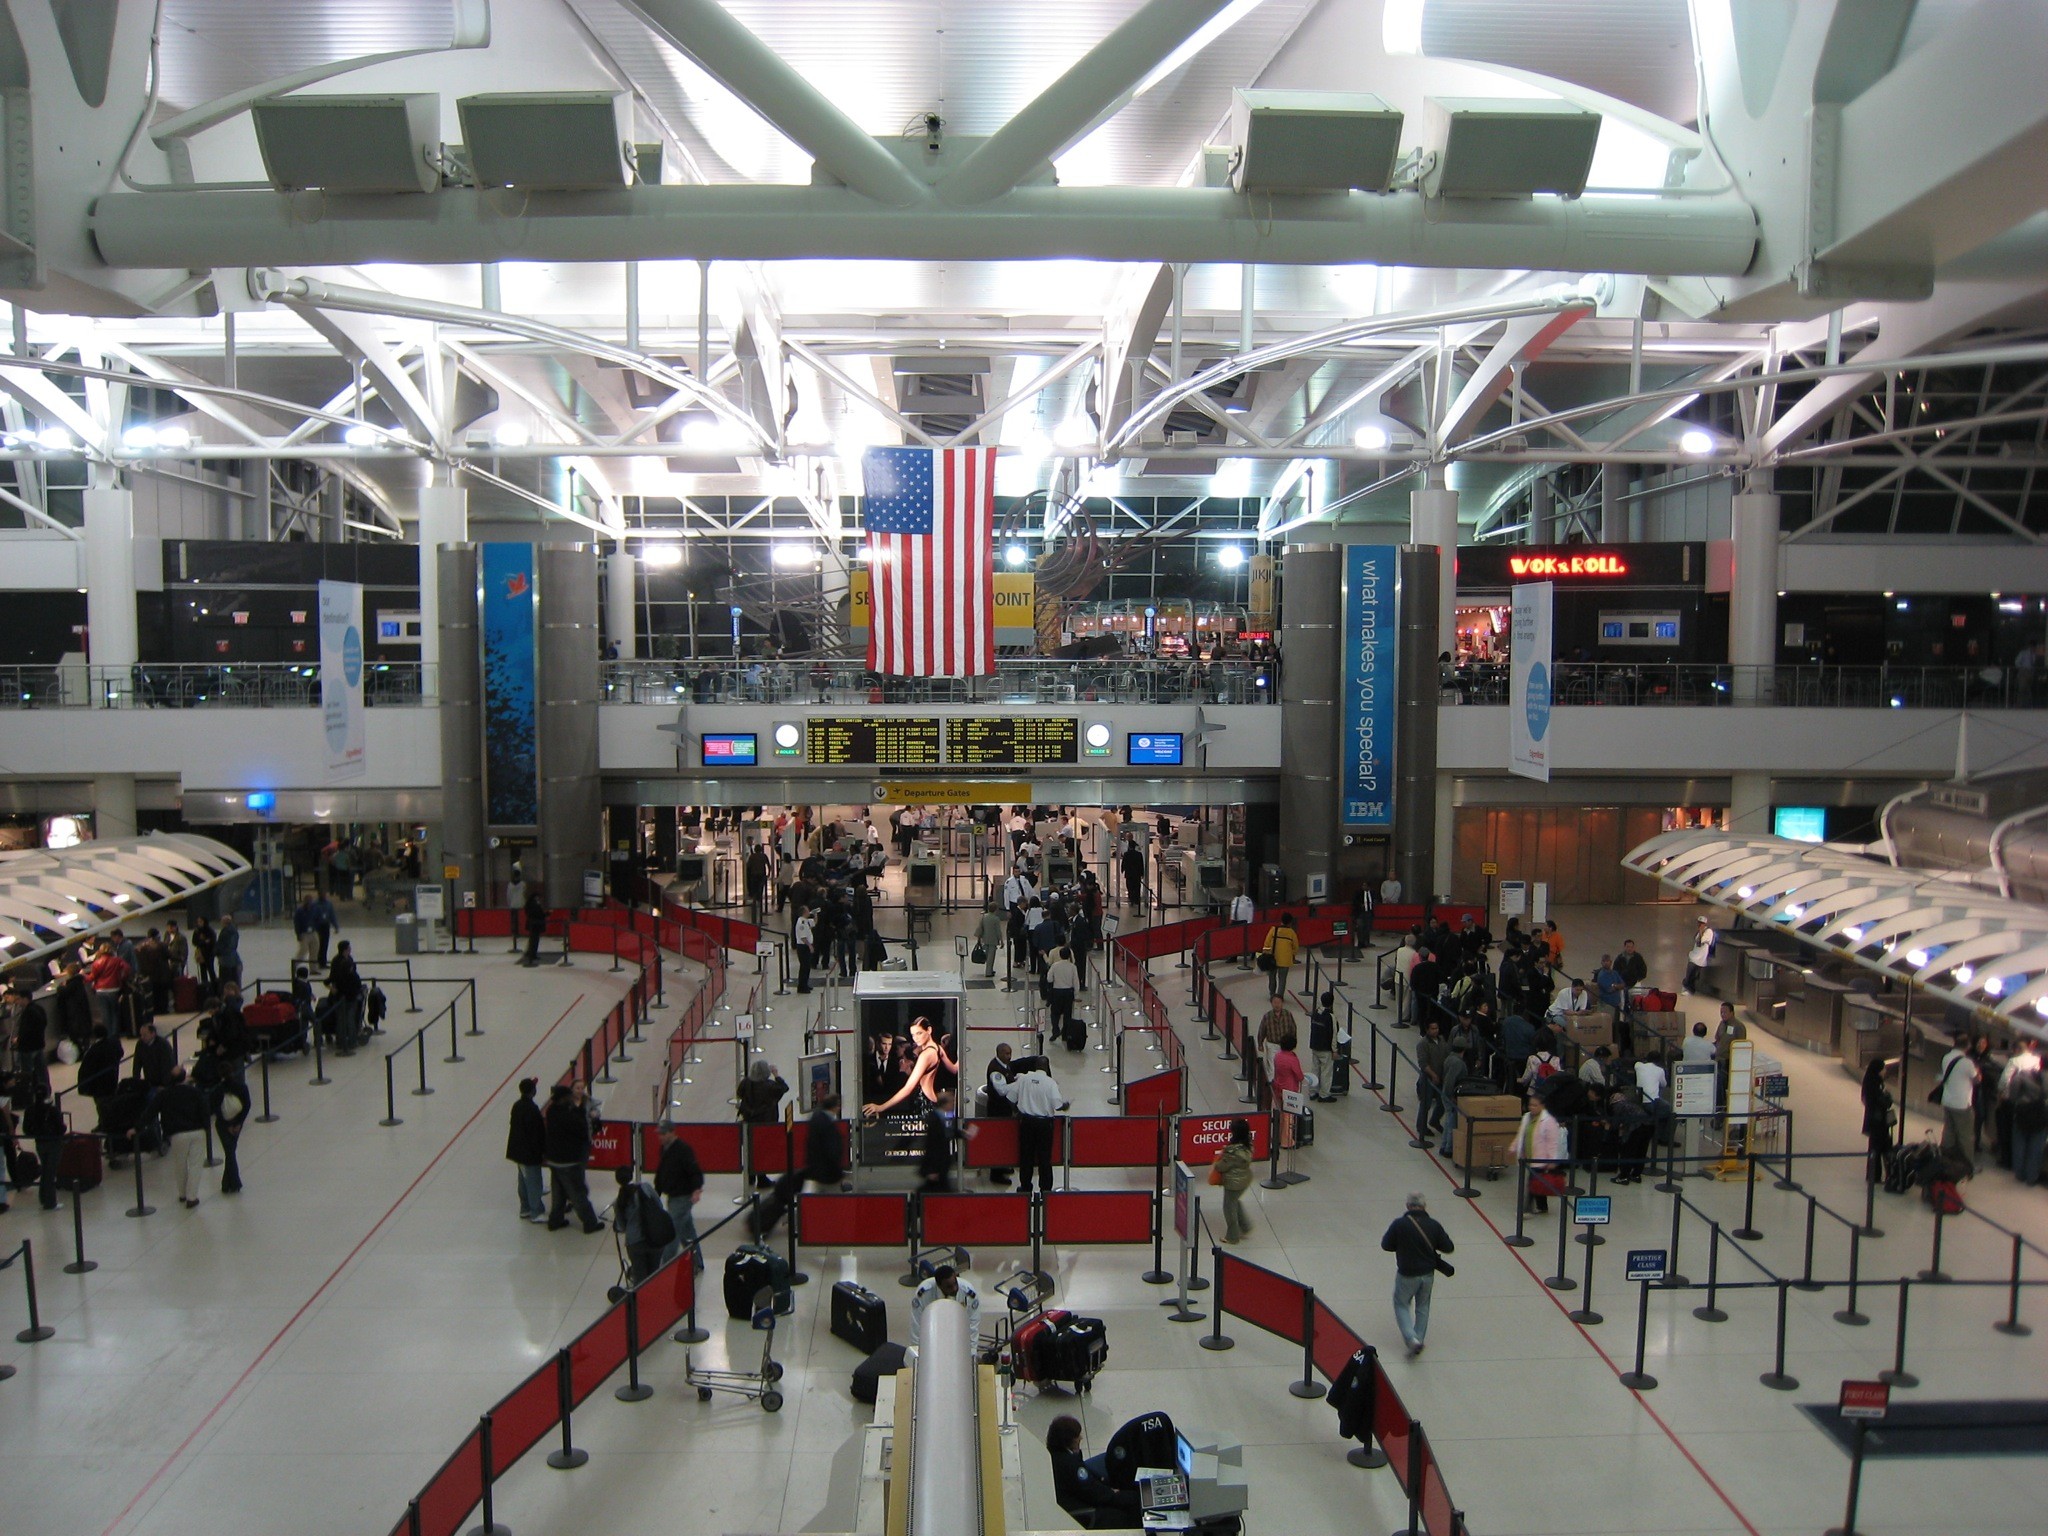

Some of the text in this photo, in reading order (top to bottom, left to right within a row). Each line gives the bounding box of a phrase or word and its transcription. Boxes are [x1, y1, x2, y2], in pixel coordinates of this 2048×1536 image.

[1355, 560, 1380, 791] what makes you special?
[904, 789, 970, 798] Departure Gates
[1349, 801, 1384, 817] IBM
[976, 826, 983, 834] 2
[1632, 1254, 1662, 1262] PRESTIGE
[1141, 1416, 1162, 1432] TSA
